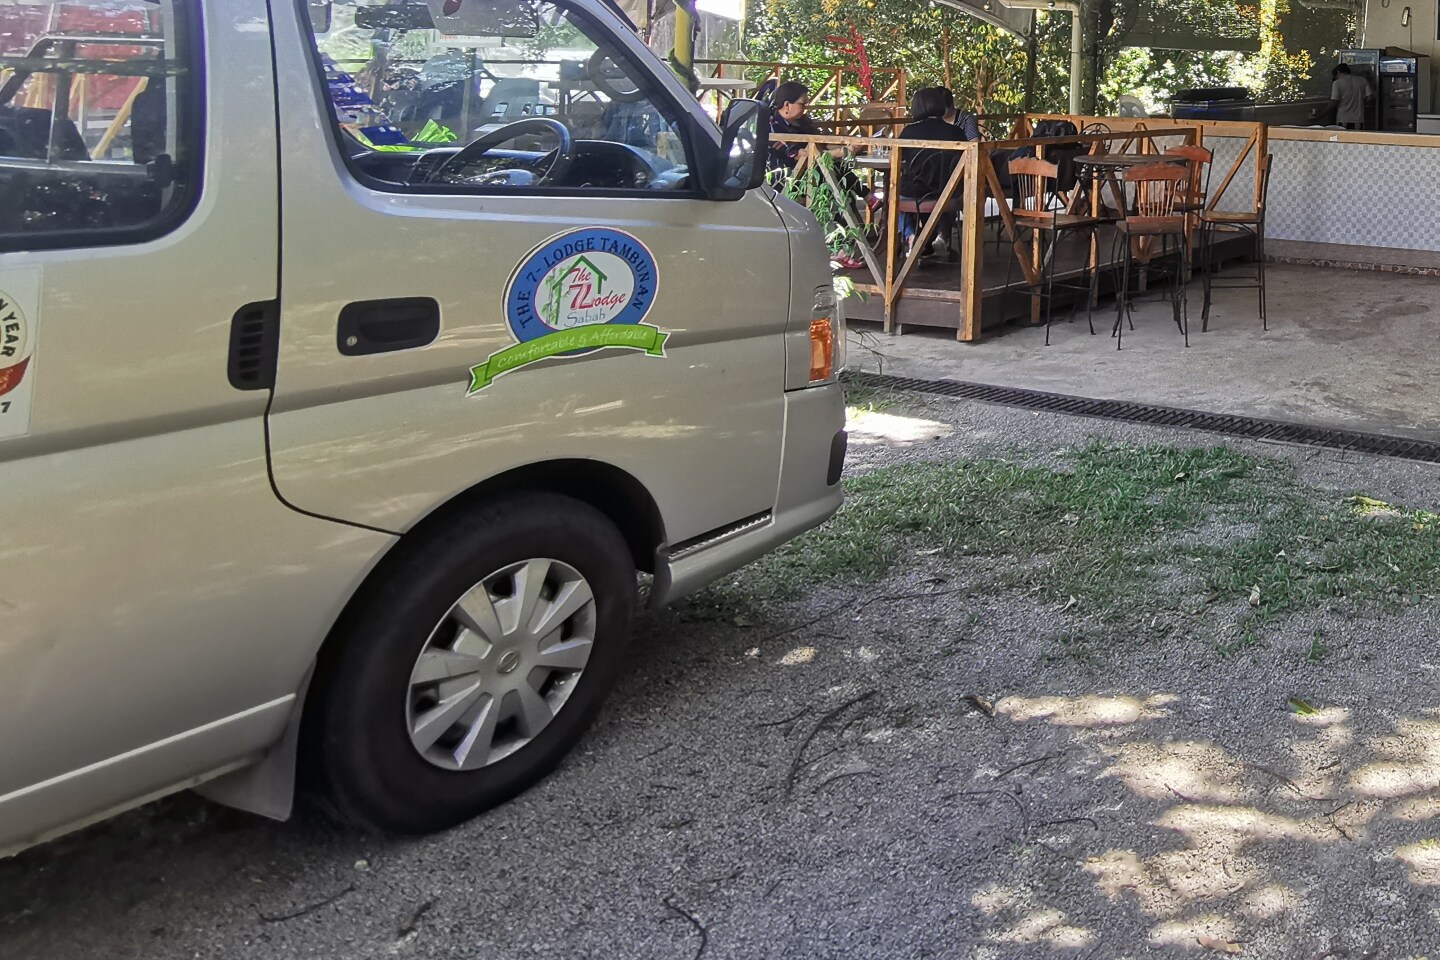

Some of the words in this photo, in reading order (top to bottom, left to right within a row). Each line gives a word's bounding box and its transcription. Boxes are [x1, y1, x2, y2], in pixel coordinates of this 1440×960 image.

[517, 290, 534, 330] THE
[600, 237, 650, 311] TAMBUNAN
[568, 267, 592, 283] The
[563, 307, 606, 328] Sabah
[0, 311, 20, 357] YEAR
[590, 326, 648, 348] Affordable
